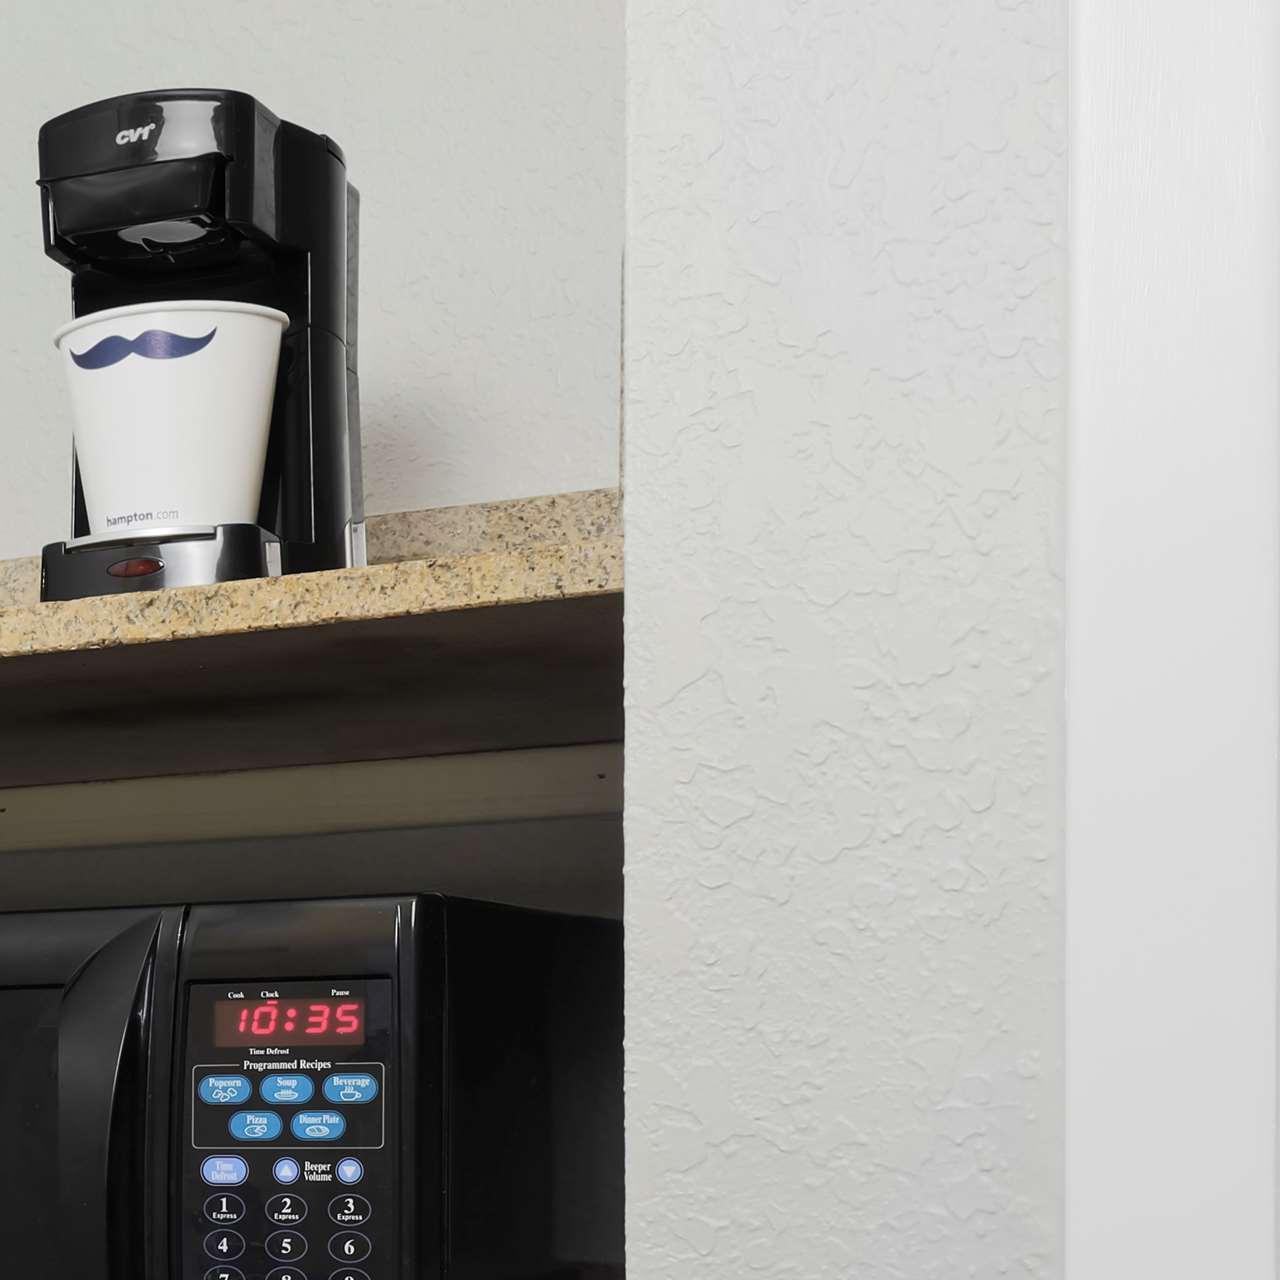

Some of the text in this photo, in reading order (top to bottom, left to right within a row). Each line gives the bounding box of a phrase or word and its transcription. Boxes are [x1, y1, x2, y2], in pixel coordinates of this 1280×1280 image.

[228, 991, 245, 999] Cook
[260, 990, 279, 998] Clock
[331, 989, 350, 997] Pause
[238, 1003, 359, 1035] 10:35
[243, 1060, 331, 1072] Programmed Recipes
[209, 1078, 241, 1088] Popcorn
[277, 1077, 297, 1088] Soup
[333, 1077, 370, 1087] Beverage
[246, 1115, 267, 1125] Pizza
[299, 1115, 339, 1125] Dinner Plate
[215, 1162, 233, 1171] Time
[305, 1162, 331, 1173] Beeper
[212, 1171, 237, 1181] Defrost
[304, 1171, 332, 1182] Volume
[220, 1198, 227, 1212] 1
[282, 1199, 291, 1212] 2
[345, 1199, 355, 1213] 3
[212, 1212, 237, 1220] Express
[274, 1213, 299, 1221] Express
[337, 1213, 362, 1221] Express
[216, 1237, 229, 1253] 4
[281, 1239, 291, 1254] 5
[344, 1240, 355, 1255] 6
